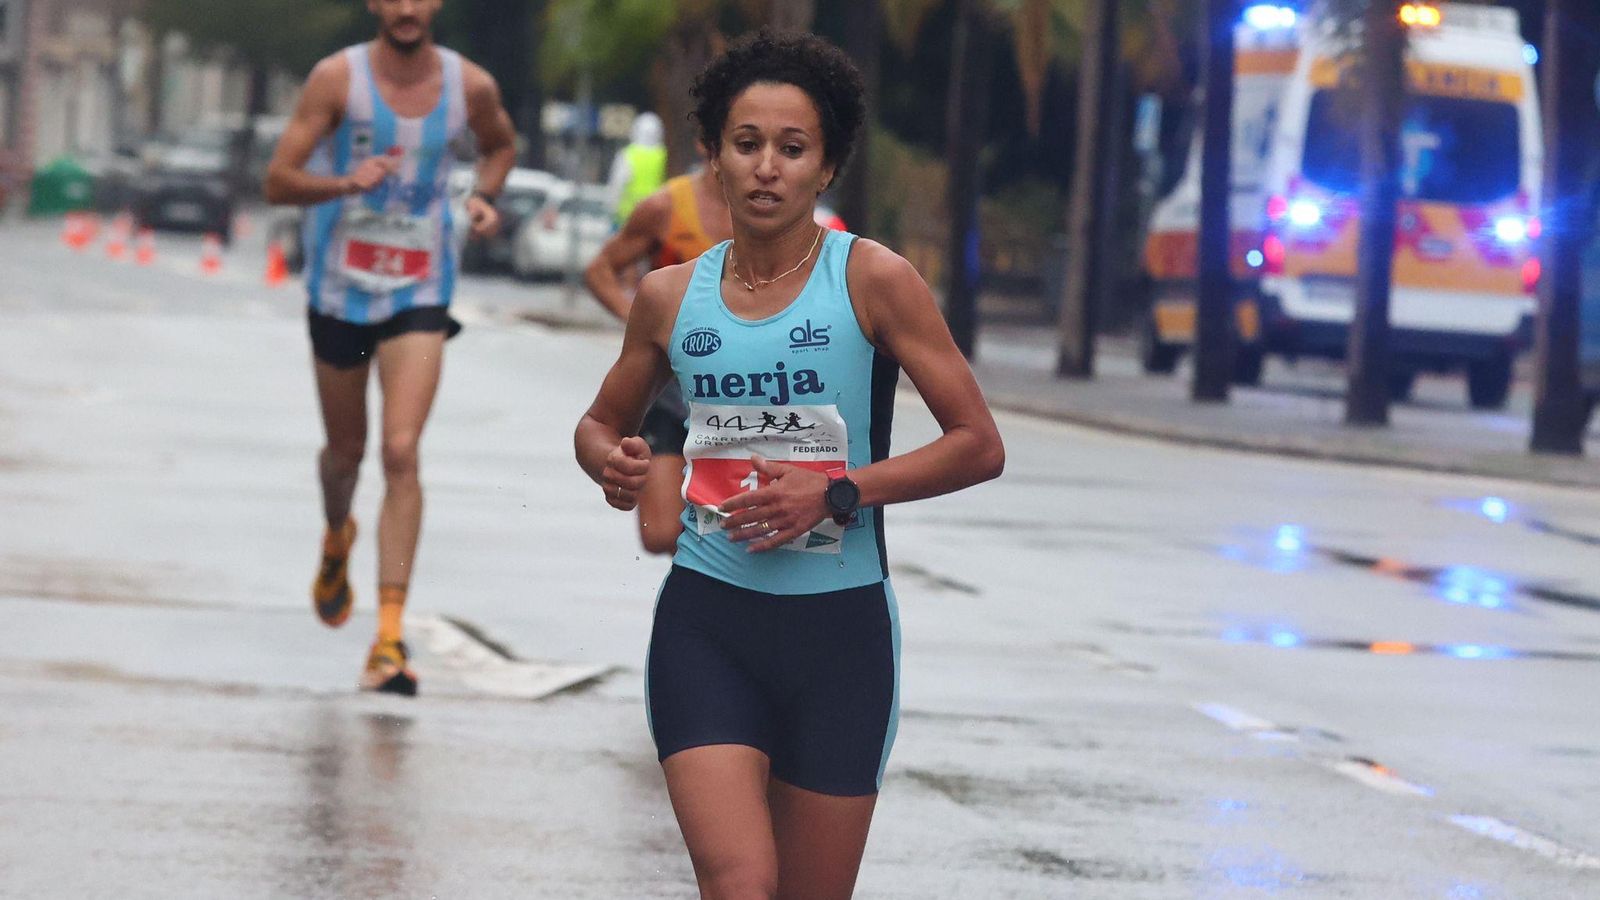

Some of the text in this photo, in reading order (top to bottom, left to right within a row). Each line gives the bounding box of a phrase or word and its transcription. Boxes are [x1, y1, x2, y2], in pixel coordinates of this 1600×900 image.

[372, 247, 405, 276] 24
[684, 333, 720, 352] TROPS
[693, 361, 825, 405] nerja
